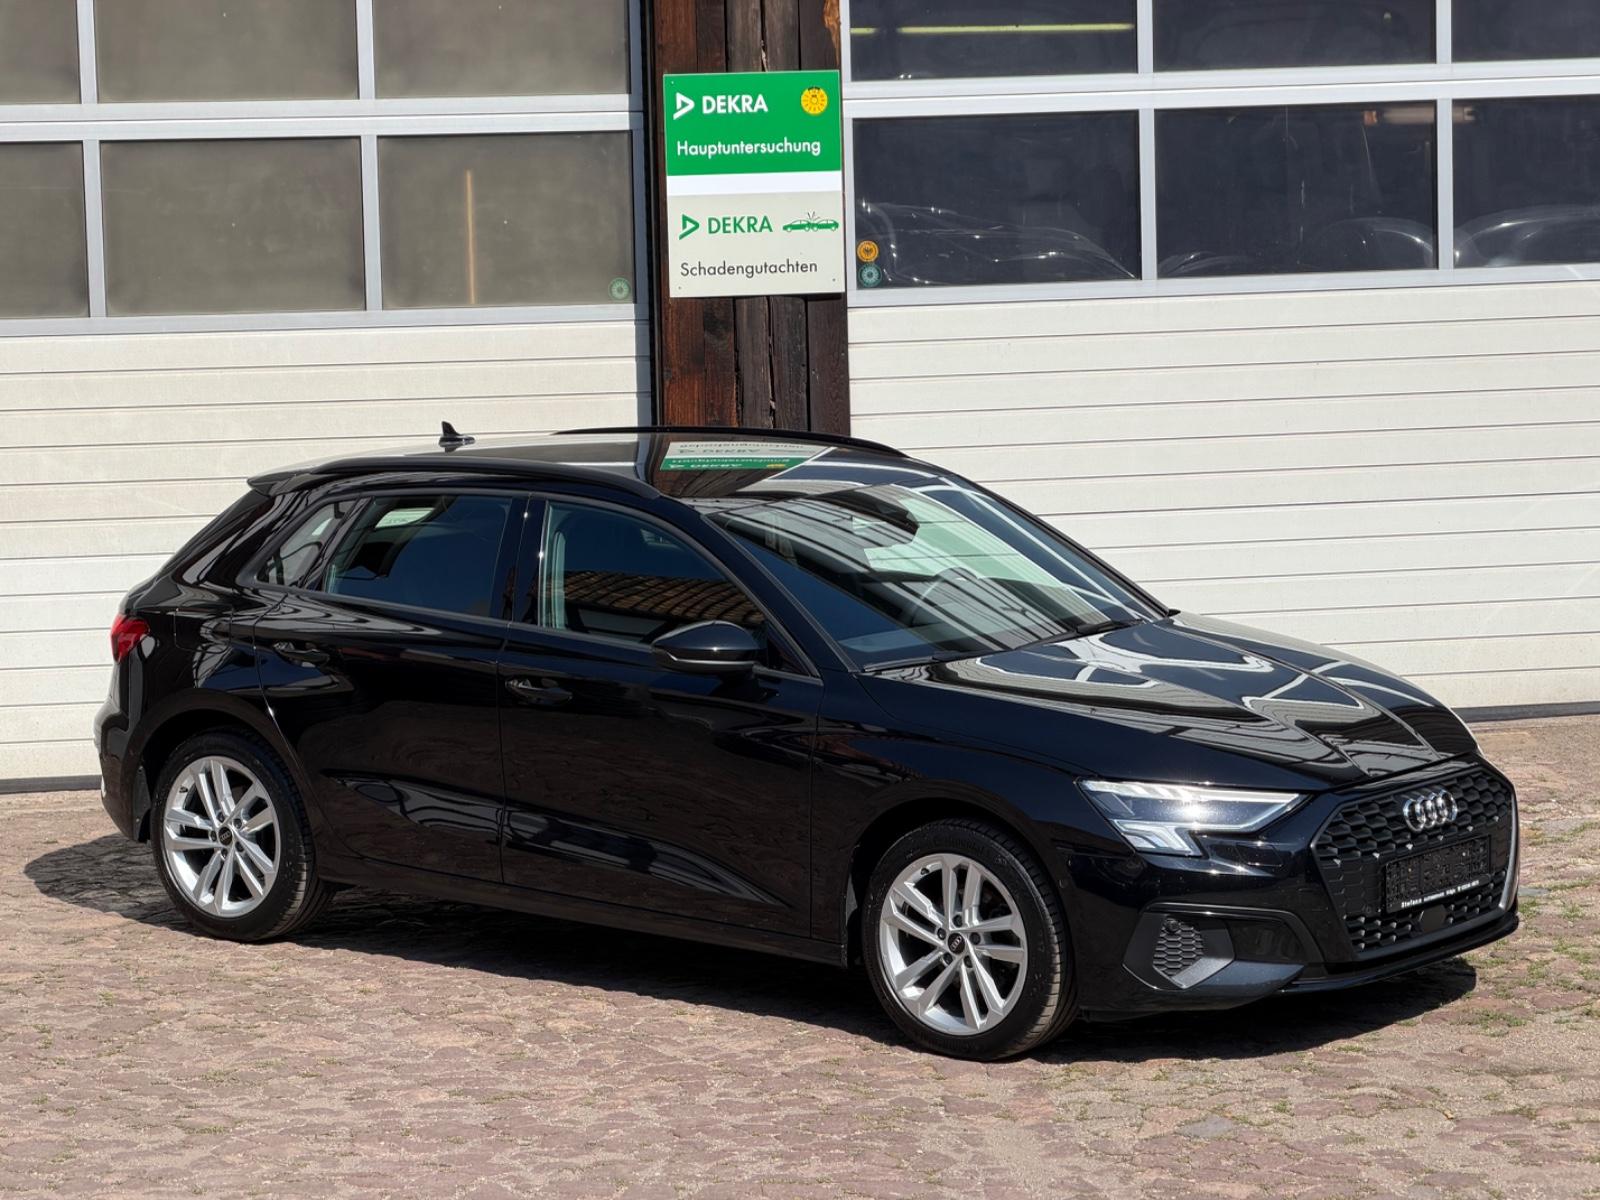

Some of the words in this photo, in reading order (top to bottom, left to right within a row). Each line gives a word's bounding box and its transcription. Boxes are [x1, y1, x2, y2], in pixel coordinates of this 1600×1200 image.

[702, 94, 768, 114] DEKRA
[677, 137, 821, 159] Hauptuntersuchung
[708, 216, 773, 234] DEKRA
[680, 259, 818, 278] Schadengutachten
